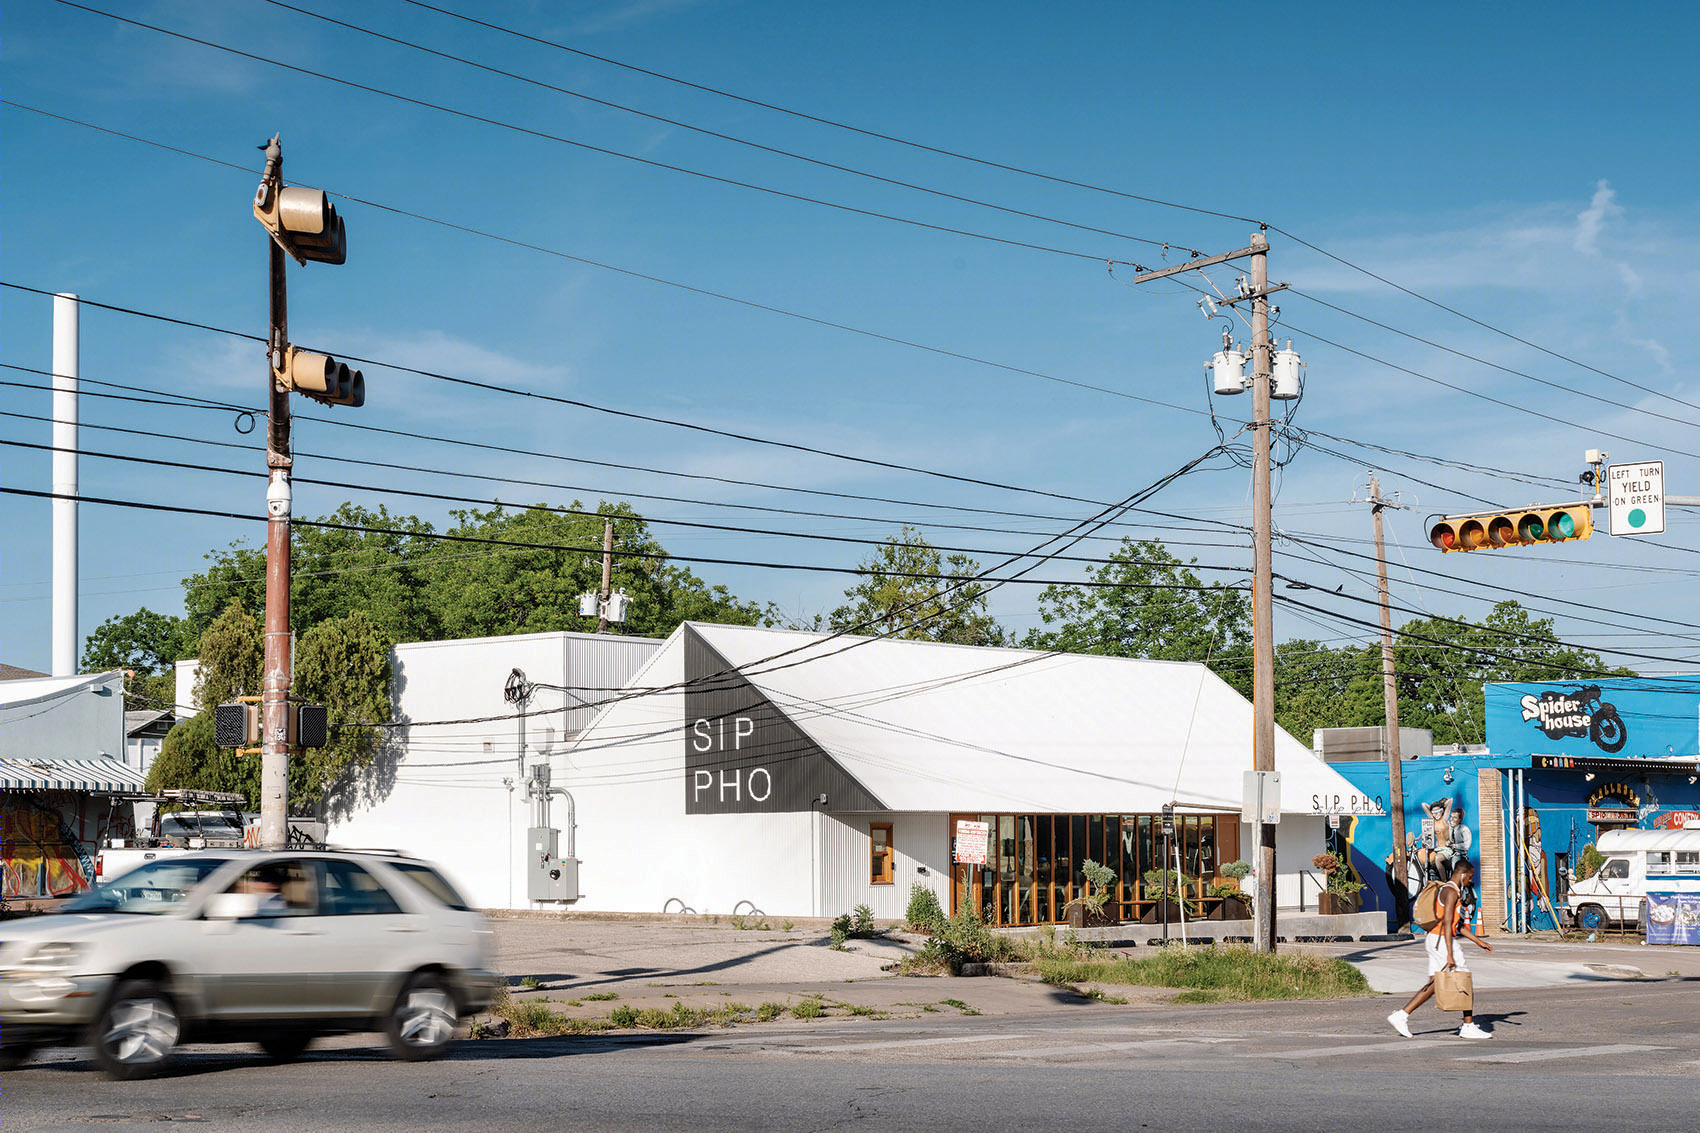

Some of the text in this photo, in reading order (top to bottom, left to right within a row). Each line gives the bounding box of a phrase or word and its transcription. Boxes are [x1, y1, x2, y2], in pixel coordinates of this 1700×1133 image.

[1612, 467, 1660, 479] LEFT TURN
[1622, 481, 1651, 493] YIELD
[1614, 494, 1660, 506] ON GREEN
[1520, 694, 1581, 722] Spider
[1545, 714, 1592, 731] house
[693, 717, 754, 752] SIP
[694, 767, 771, 803] PHO
[1312, 794, 1383, 811] SIP PHO
